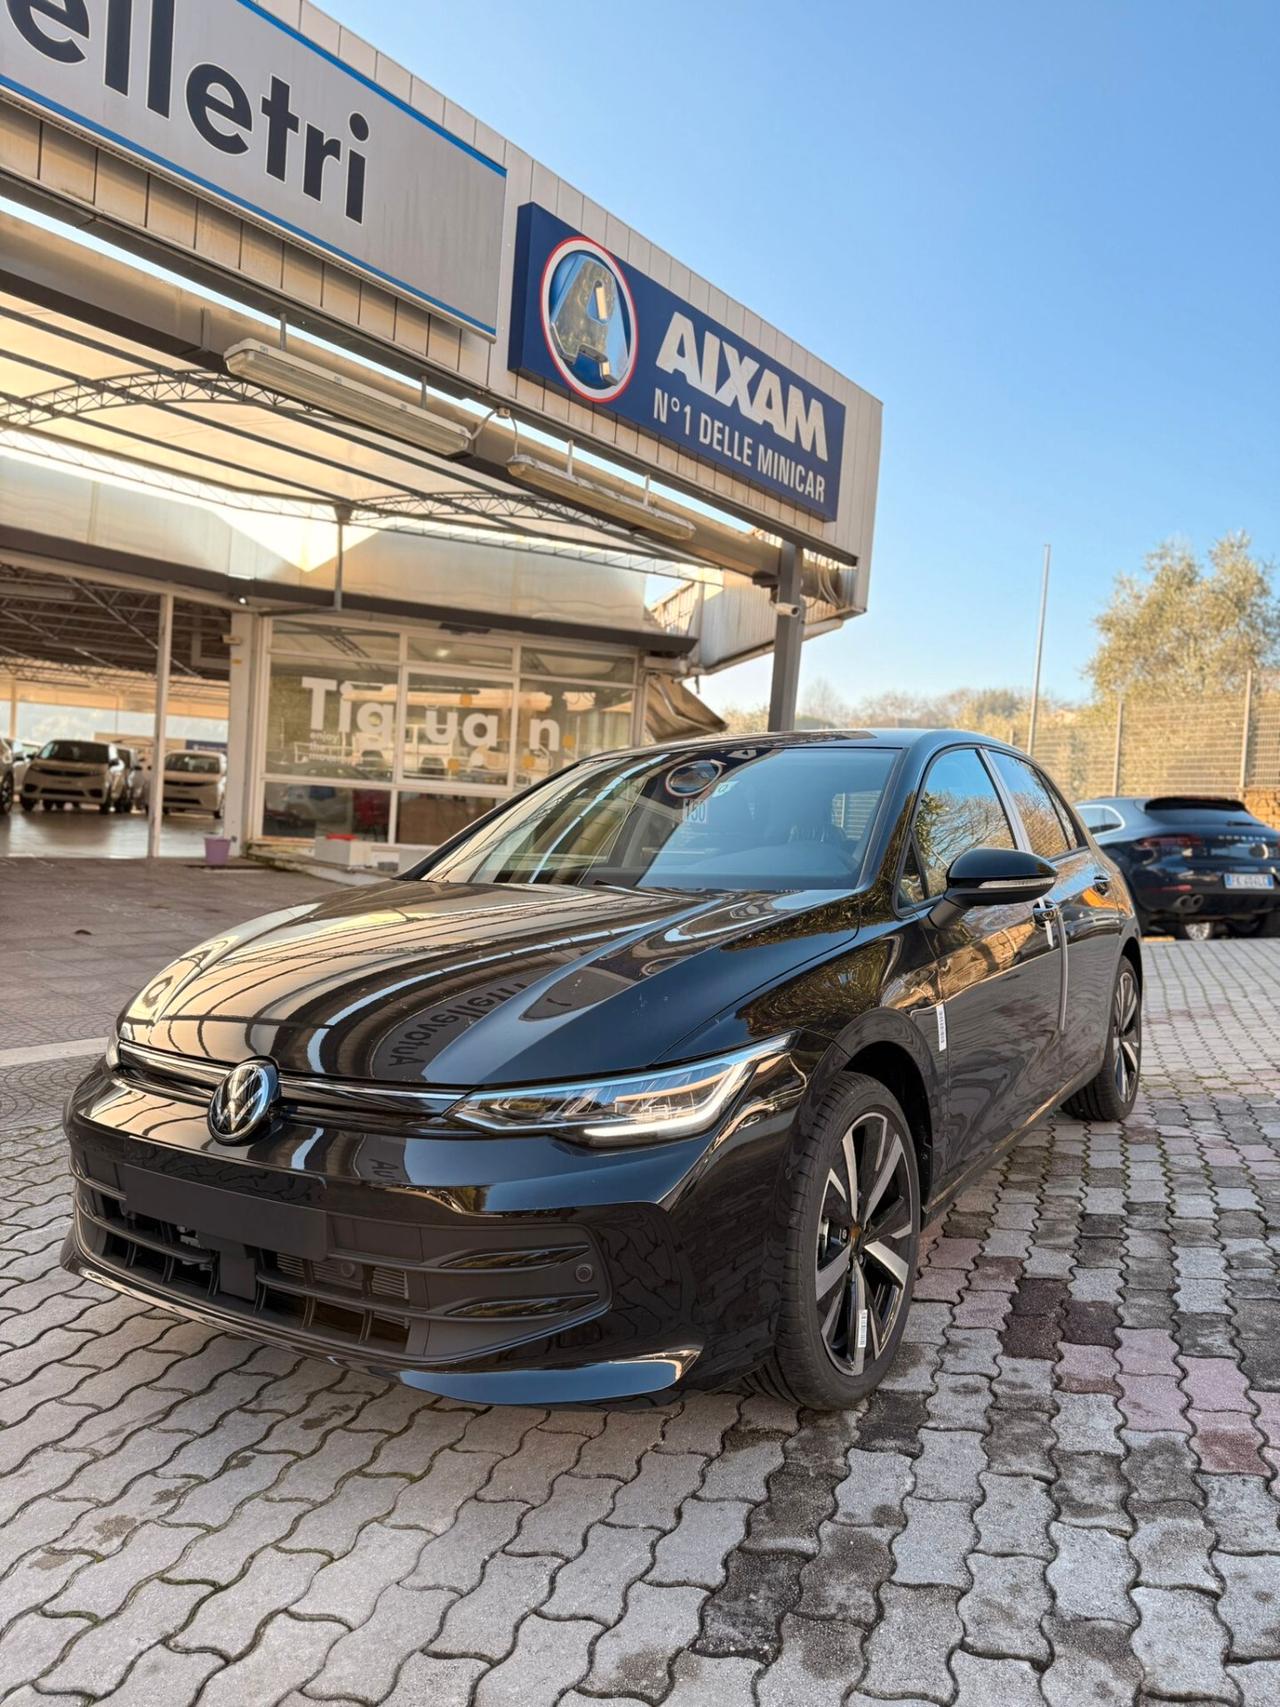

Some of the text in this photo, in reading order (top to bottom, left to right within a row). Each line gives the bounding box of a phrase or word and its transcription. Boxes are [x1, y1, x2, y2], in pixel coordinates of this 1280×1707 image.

[655, 311, 829, 462] AIXAM
[699, 412, 752, 467] DELLE
[757, 444, 827, 504] MINICAR
